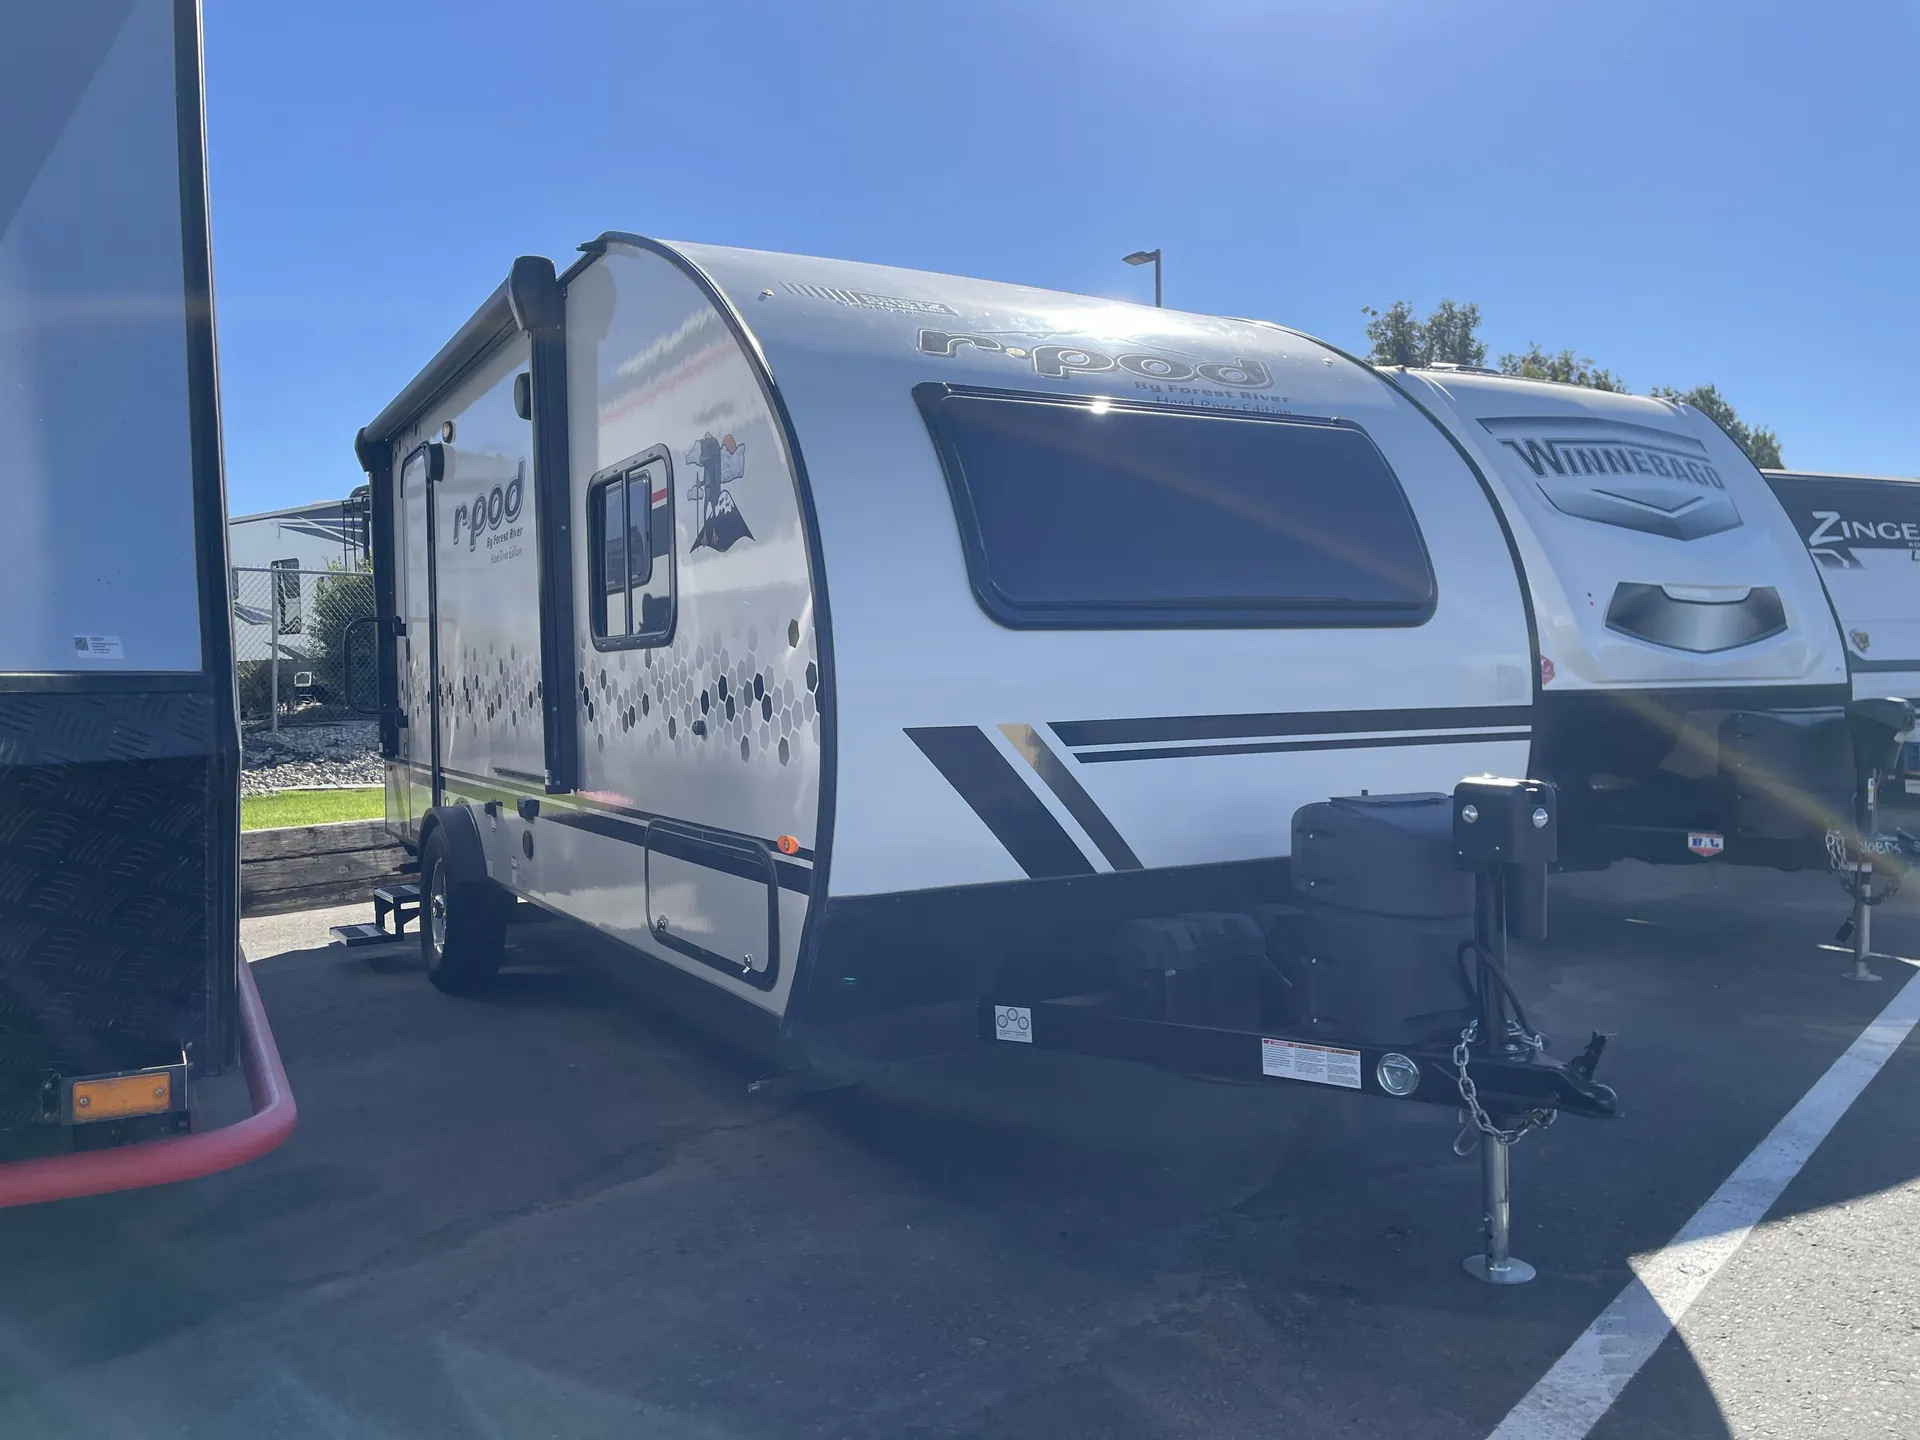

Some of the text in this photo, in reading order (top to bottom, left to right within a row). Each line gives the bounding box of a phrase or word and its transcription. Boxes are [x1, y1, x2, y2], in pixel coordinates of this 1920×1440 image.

[1134, 382, 1290, 403] By Forest River
[1497, 437, 1726, 490] WINNEBAGO
[486, 527, 523, 550] By Forest River
